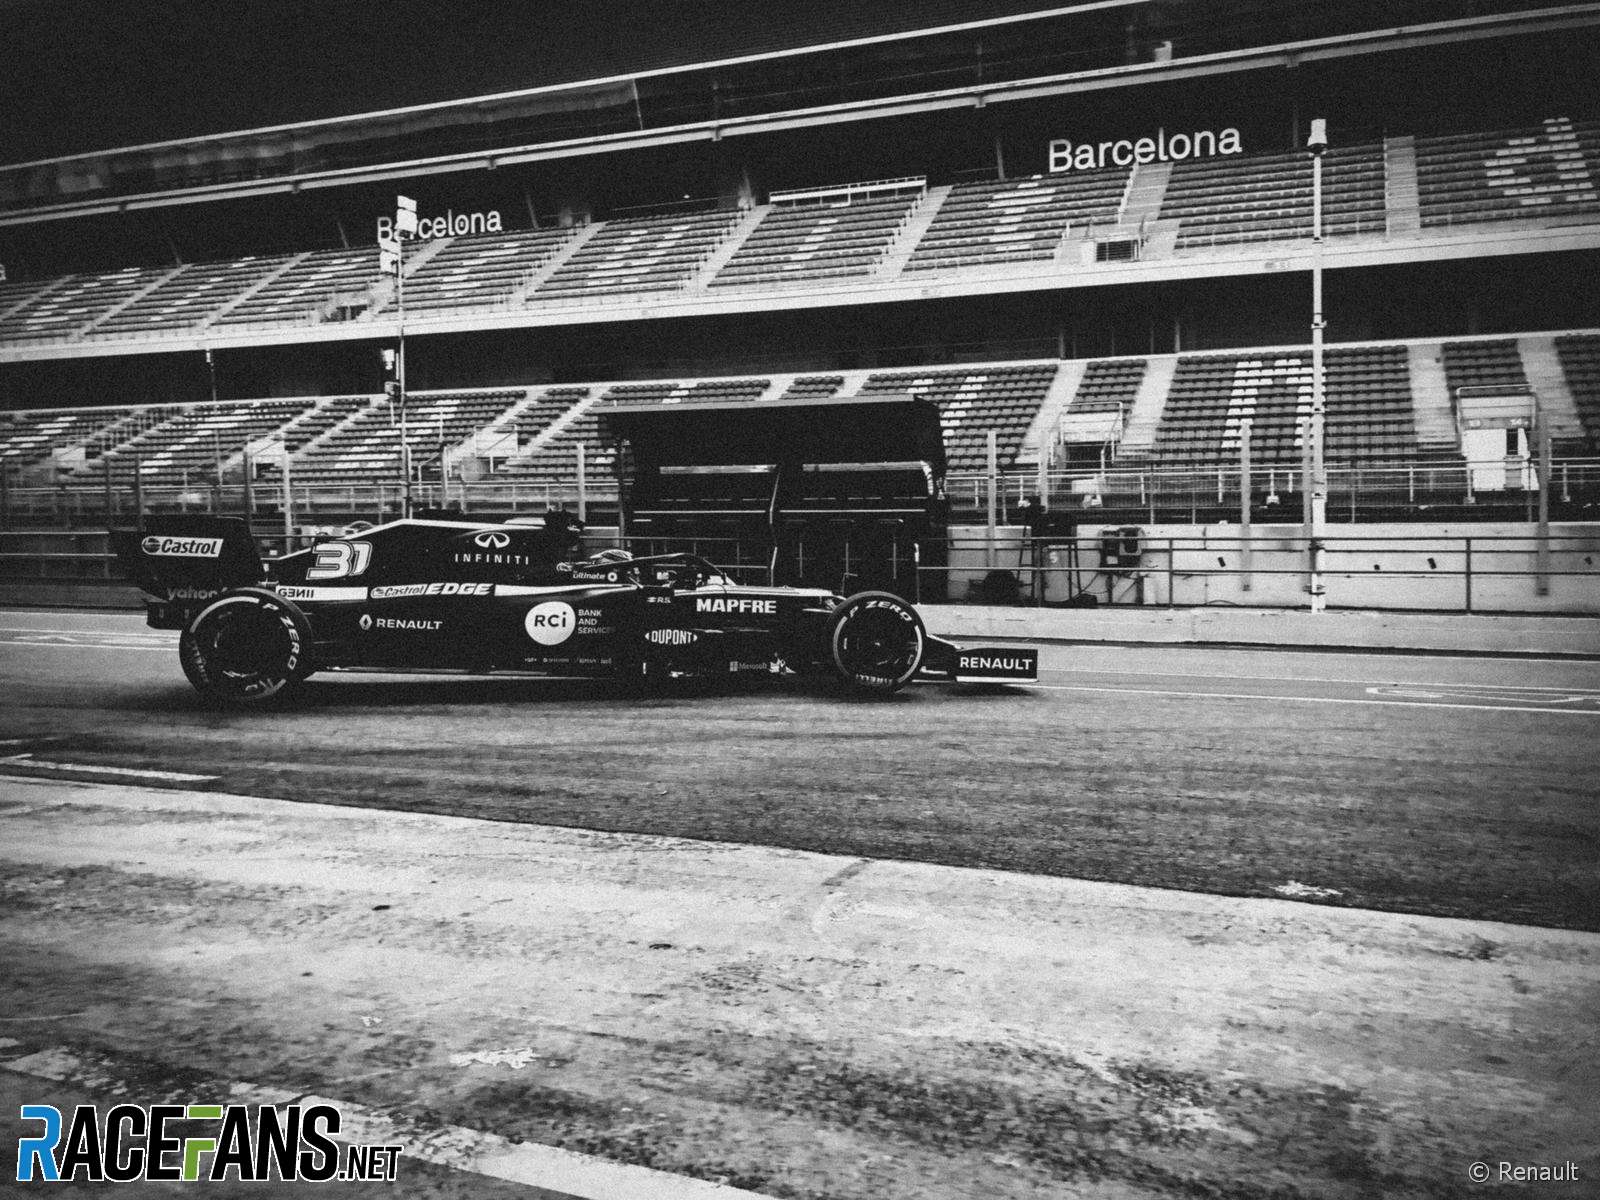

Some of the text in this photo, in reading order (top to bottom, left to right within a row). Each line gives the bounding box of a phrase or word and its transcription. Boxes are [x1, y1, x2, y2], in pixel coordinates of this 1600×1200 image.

[1049, 126, 1243, 173] Barcelona
[377, 208, 503, 242] Bcelona
[161, 539, 218, 555] Castrol
[306, 540, 373, 580] 31
[454, 552, 530, 566] INFINITI
[385, 582, 494, 598] Castrol EDGE
[577, 608, 602, 617] BANK
[696, 598, 777, 614] MAPFRE
[865, 600, 912, 622] ZERO
[376, 618, 444, 631] RENAULT
[533, 611, 568, 629] RCi
[577, 618, 599, 626] AND
[280, 616, 300, 671] ZERO
[651, 629, 693, 645] DUPONT
[959, 656, 1033, 671] RENAULT
